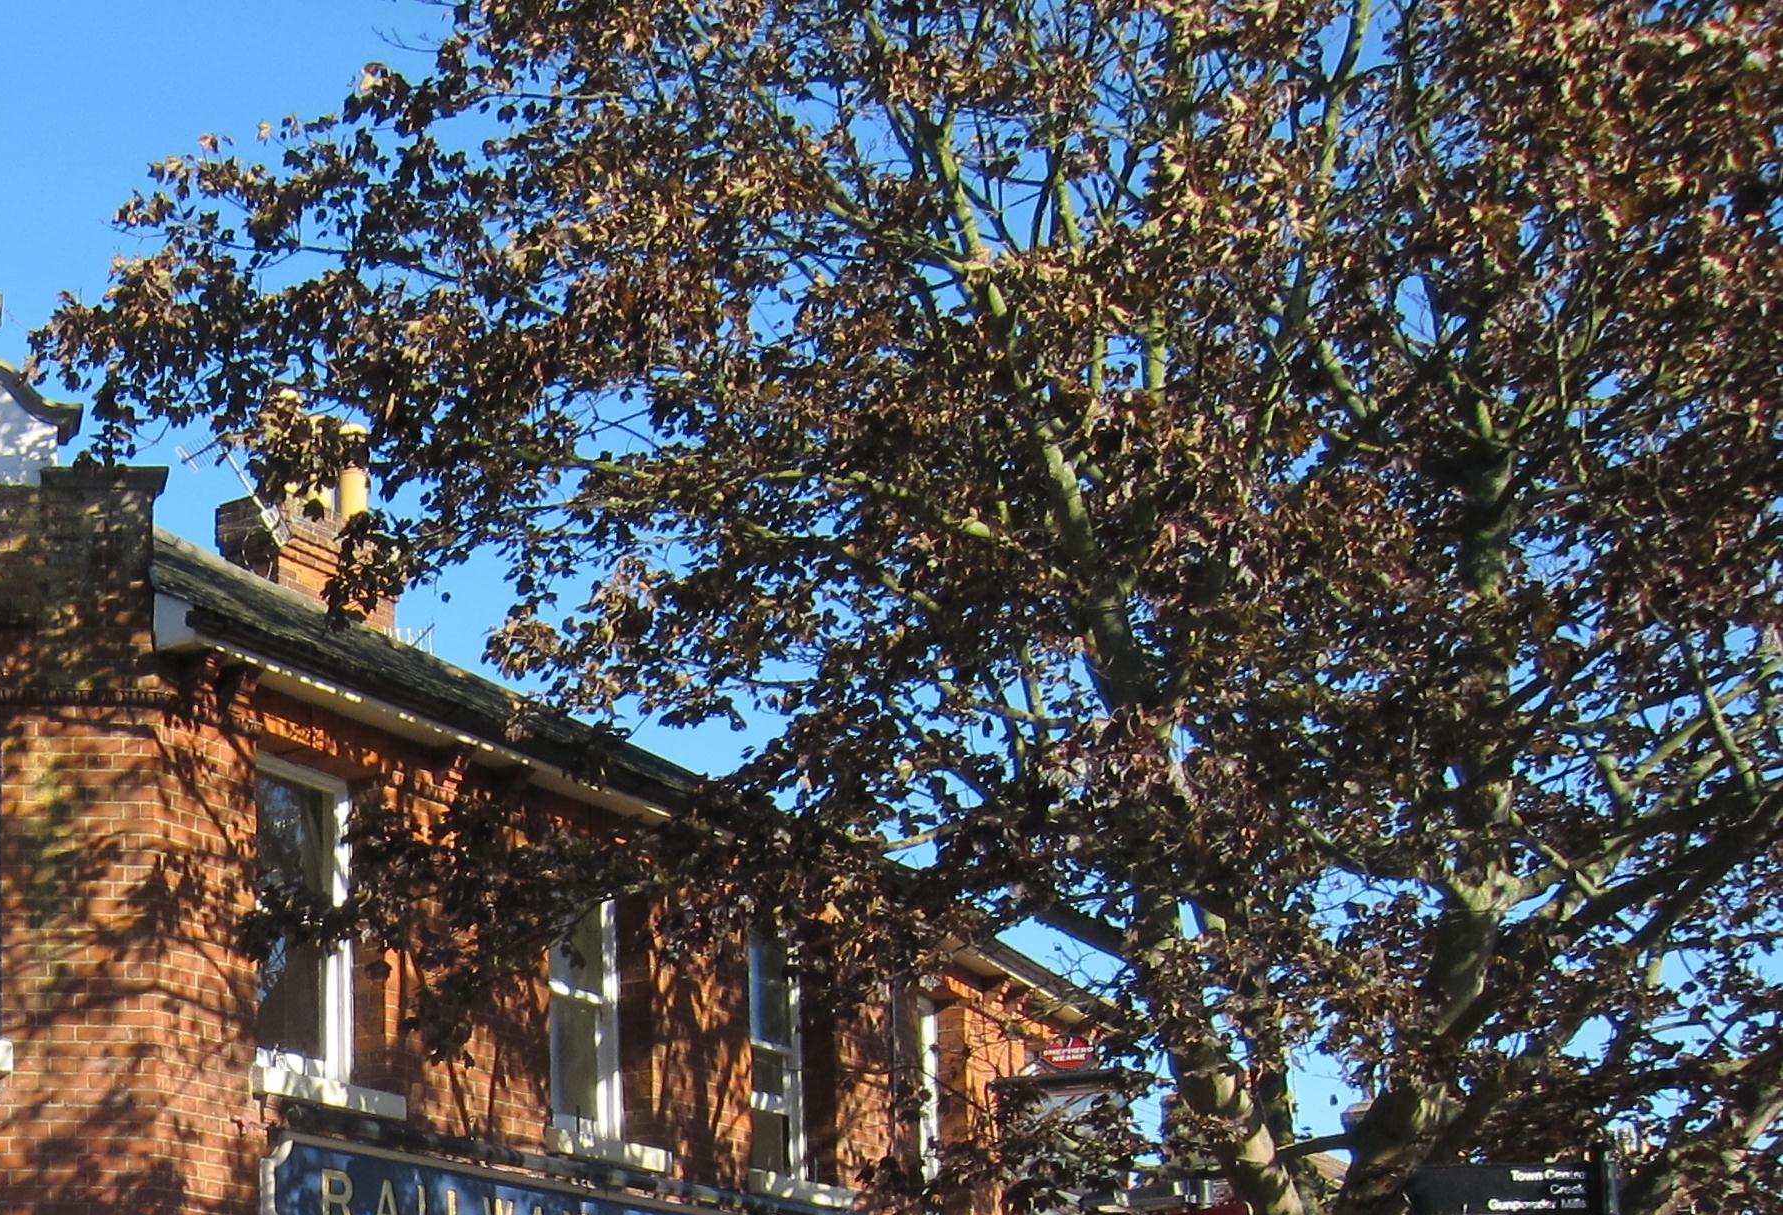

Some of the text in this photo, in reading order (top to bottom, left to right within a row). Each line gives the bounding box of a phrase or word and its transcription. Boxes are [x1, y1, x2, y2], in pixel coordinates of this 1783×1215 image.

[1051, 1053, 1086, 1062] NEAME
[1510, 1168, 1586, 1182] Town Centre
[1549, 1183, 1586, 1195] Creek
[1487, 1198, 1556, 1212] Gunpowder
